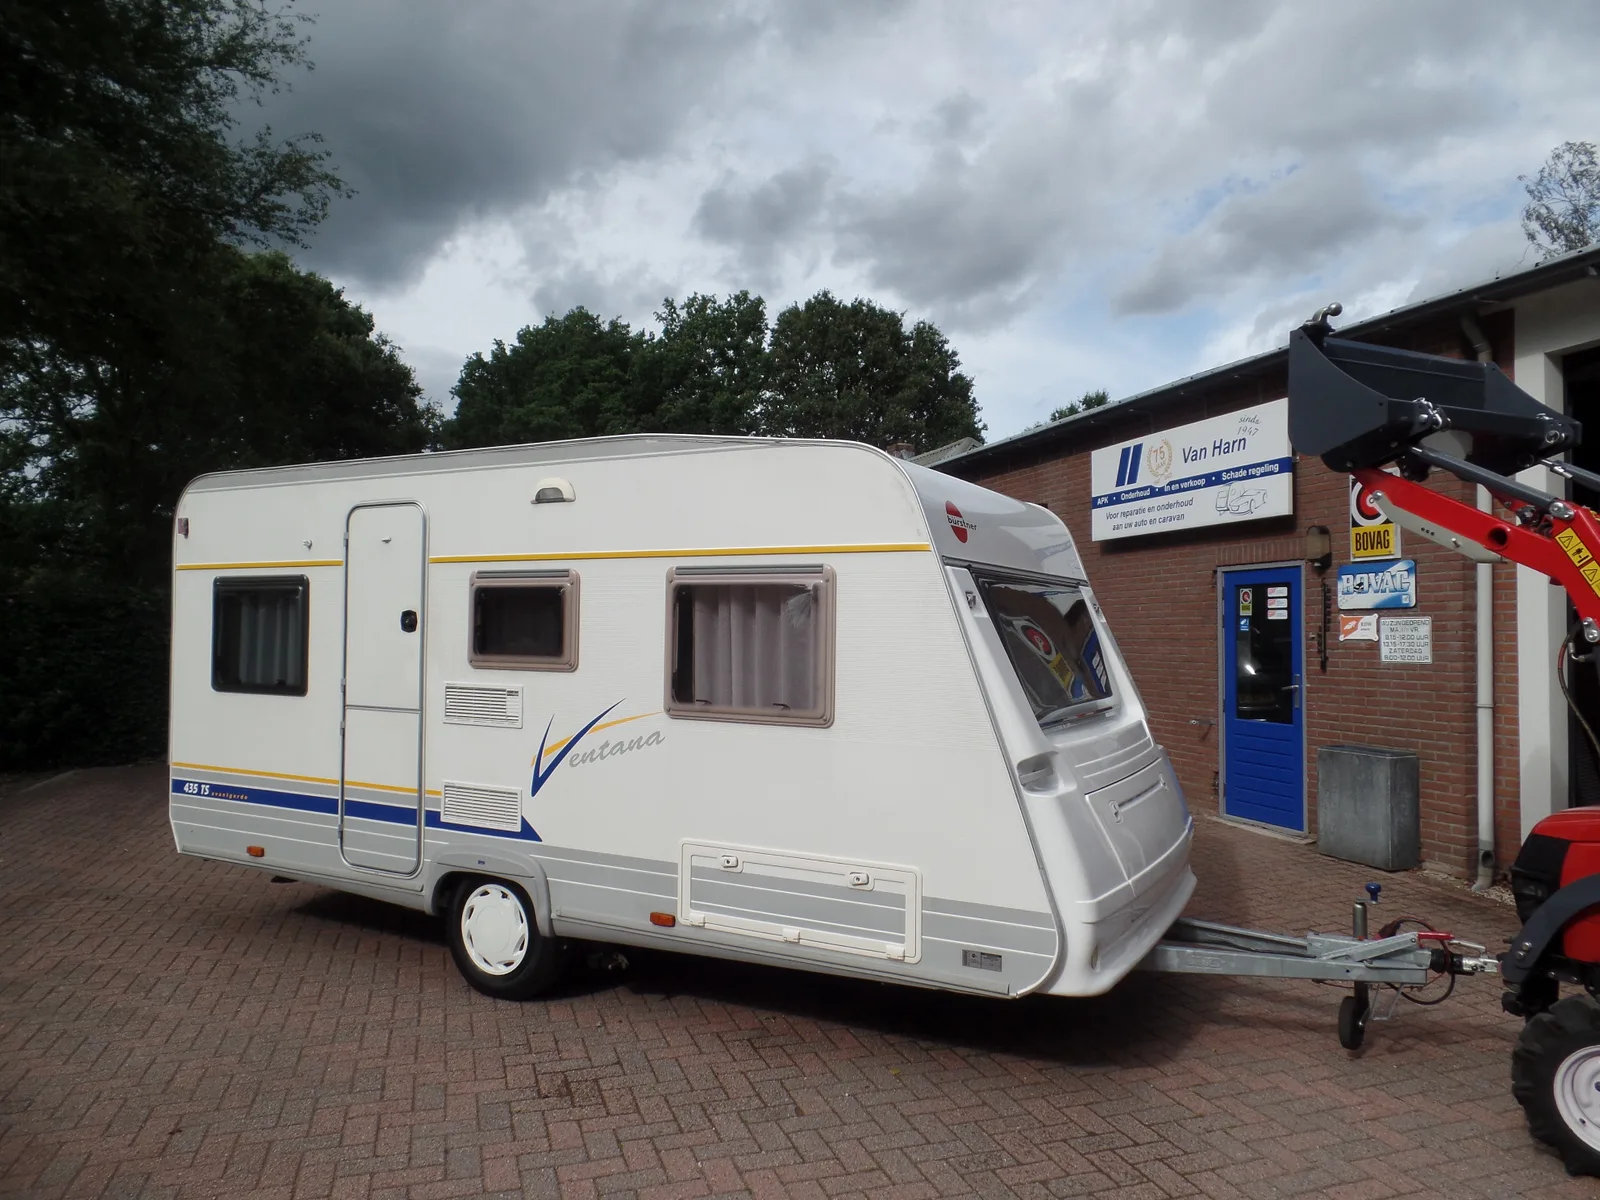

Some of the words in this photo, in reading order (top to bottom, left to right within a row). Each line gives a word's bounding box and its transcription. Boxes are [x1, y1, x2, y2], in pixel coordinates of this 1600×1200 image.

[1237, 426, 1259, 437] 1947
[1153, 446, 1165, 463] 75
[1182, 446, 1207, 464] Van
[1212, 437, 1247, 457] Harn
[1097, 496, 1109, 506] APK
[1120, 488, 1150, 501] Onderhoud
[1164, 483, 1170, 492] In
[1171, 483, 1180, 491] en
[1180, 478, 1206, 490] verkoop
[1222, 469, 1247, 481] Schade
[1248, 463, 1279, 476] regeling
[1105, 511, 1119, 520] Voor
[1120, 506, 1146, 519] reparatie
[1147, 505, 1156, 513] en
[1156, 497, 1194, 512] onderhoud
[946, 515, 977, 530] bürstner
[1112, 523, 1124, 531] aan
[1124, 521, 1133, 529] uw
[1134, 517, 1148, 527] auto
[1149, 517, 1157, 525] en
[1158, 513, 1185, 524] caravan
[1355, 529, 1390, 552] BOVAG
[530, 697, 665, 797] Ventana
[183, 782, 198, 794] 435
[200, 784, 210, 795] TS
